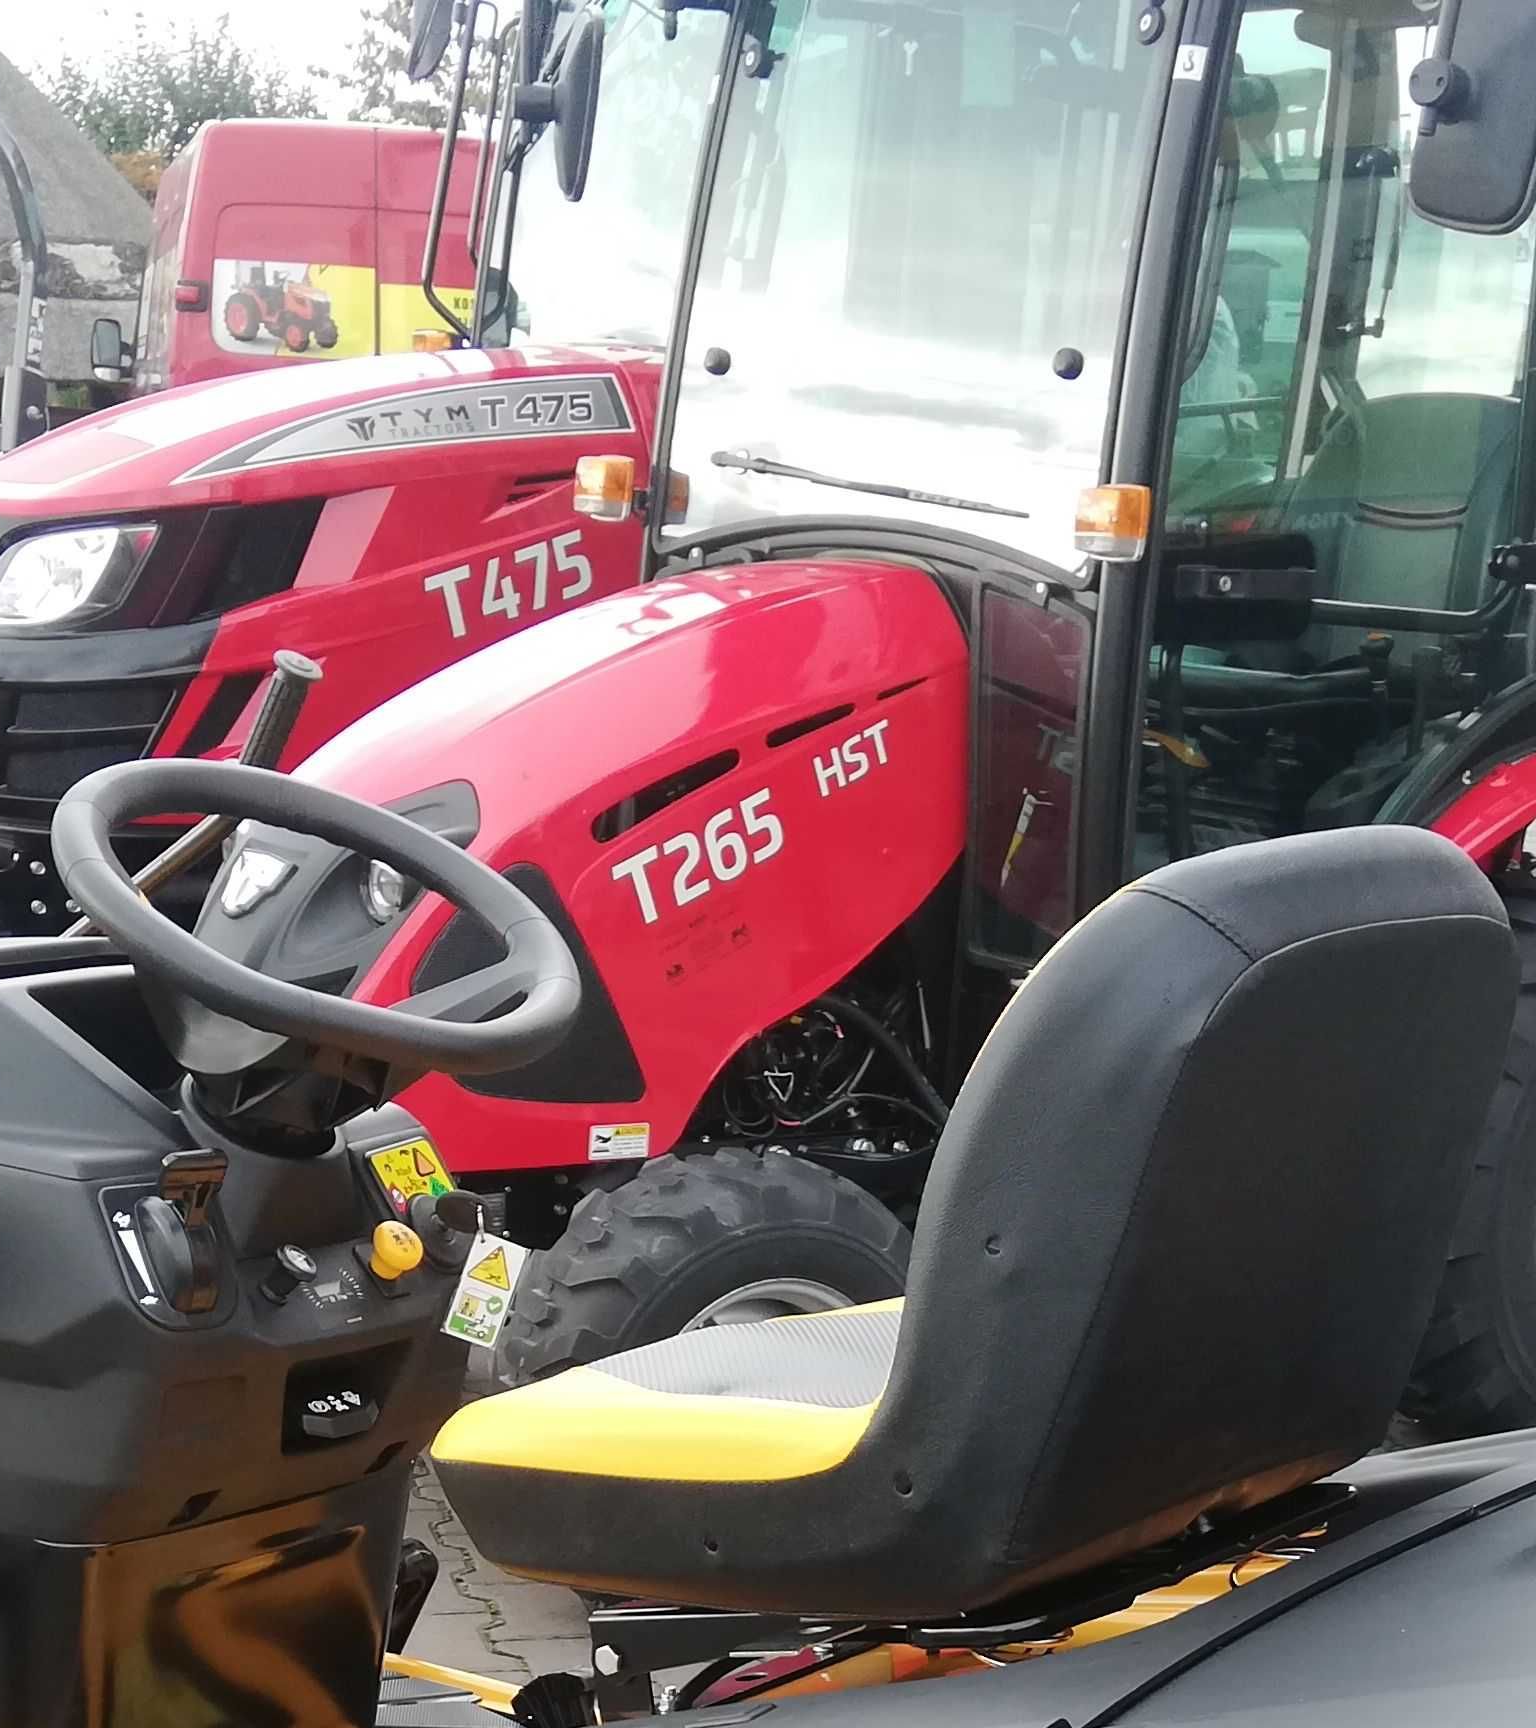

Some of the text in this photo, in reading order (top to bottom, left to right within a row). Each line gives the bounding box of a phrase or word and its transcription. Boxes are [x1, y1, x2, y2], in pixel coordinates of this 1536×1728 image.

[379, 403, 470, 427] TYM
[390, 421, 475, 440] TRACTORS
[424, 529, 593, 639] T475
[813, 719, 888, 798] HST
[611, 787, 784, 924] T265
